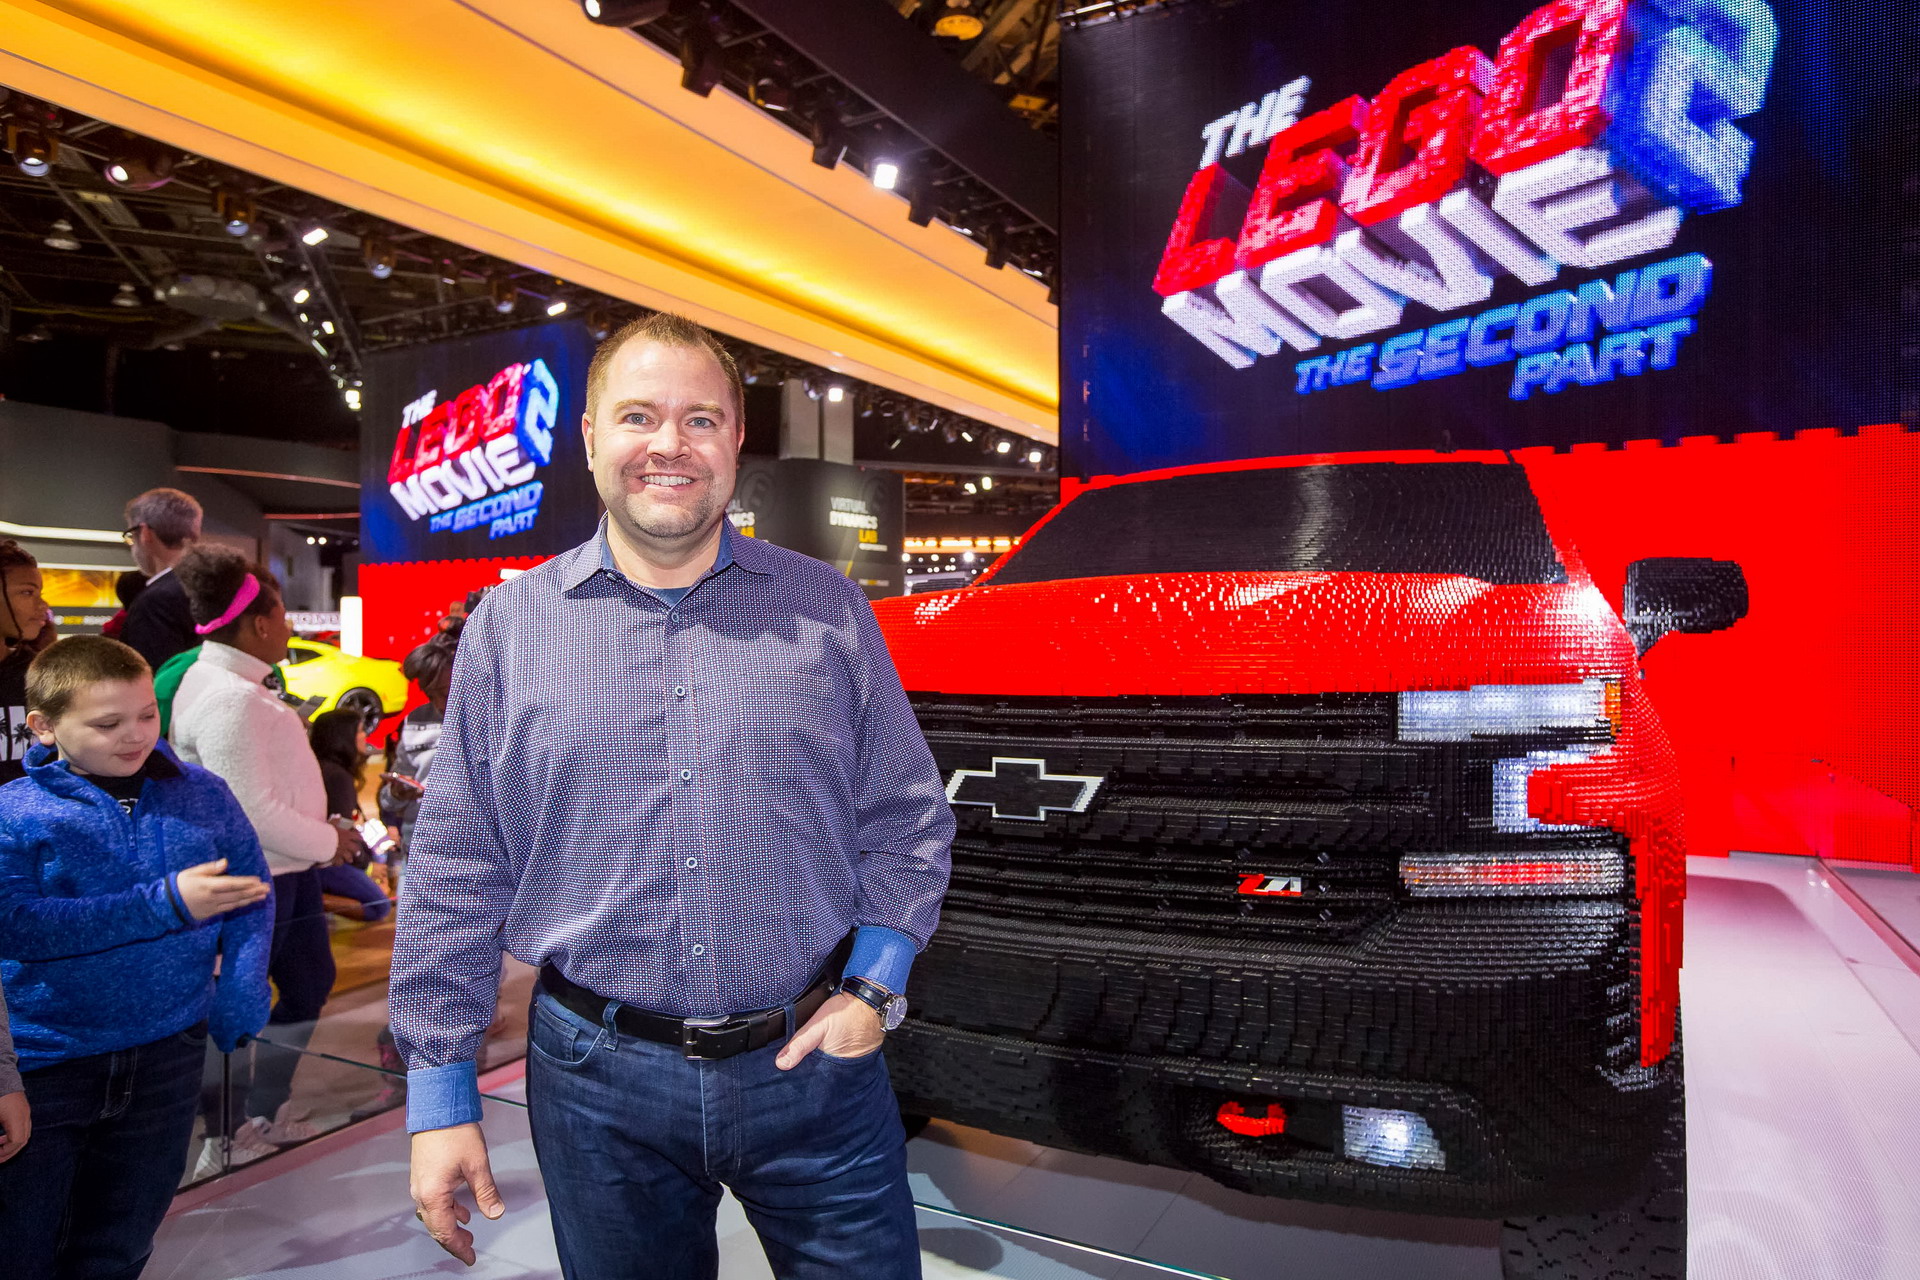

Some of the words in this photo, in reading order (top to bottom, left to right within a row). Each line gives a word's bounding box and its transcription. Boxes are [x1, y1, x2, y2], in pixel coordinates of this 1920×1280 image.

[1152, 0, 1628, 297] LEGO
[1200, 75, 1313, 167] THE
[1602, 0, 1778, 214] 2
[1161, 146, 1687, 370] MOVIE
[1294, 341, 1377, 395] THE
[1370, 252, 1713, 391] SECOND
[1509, 318, 1699, 400] PART
[387, 362, 524, 485] LEGO
[402, 389, 437, 429] THE
[517, 358, 559, 467] 2
[390, 433, 536, 521] MOVIE
[429, 514, 453, 533] THE
[451, 480, 544, 534] SECOND
[829, 510, 878, 530] DYNAMICS
[489, 508, 538, 541] PART
[858, 528, 878, 544] LAB
